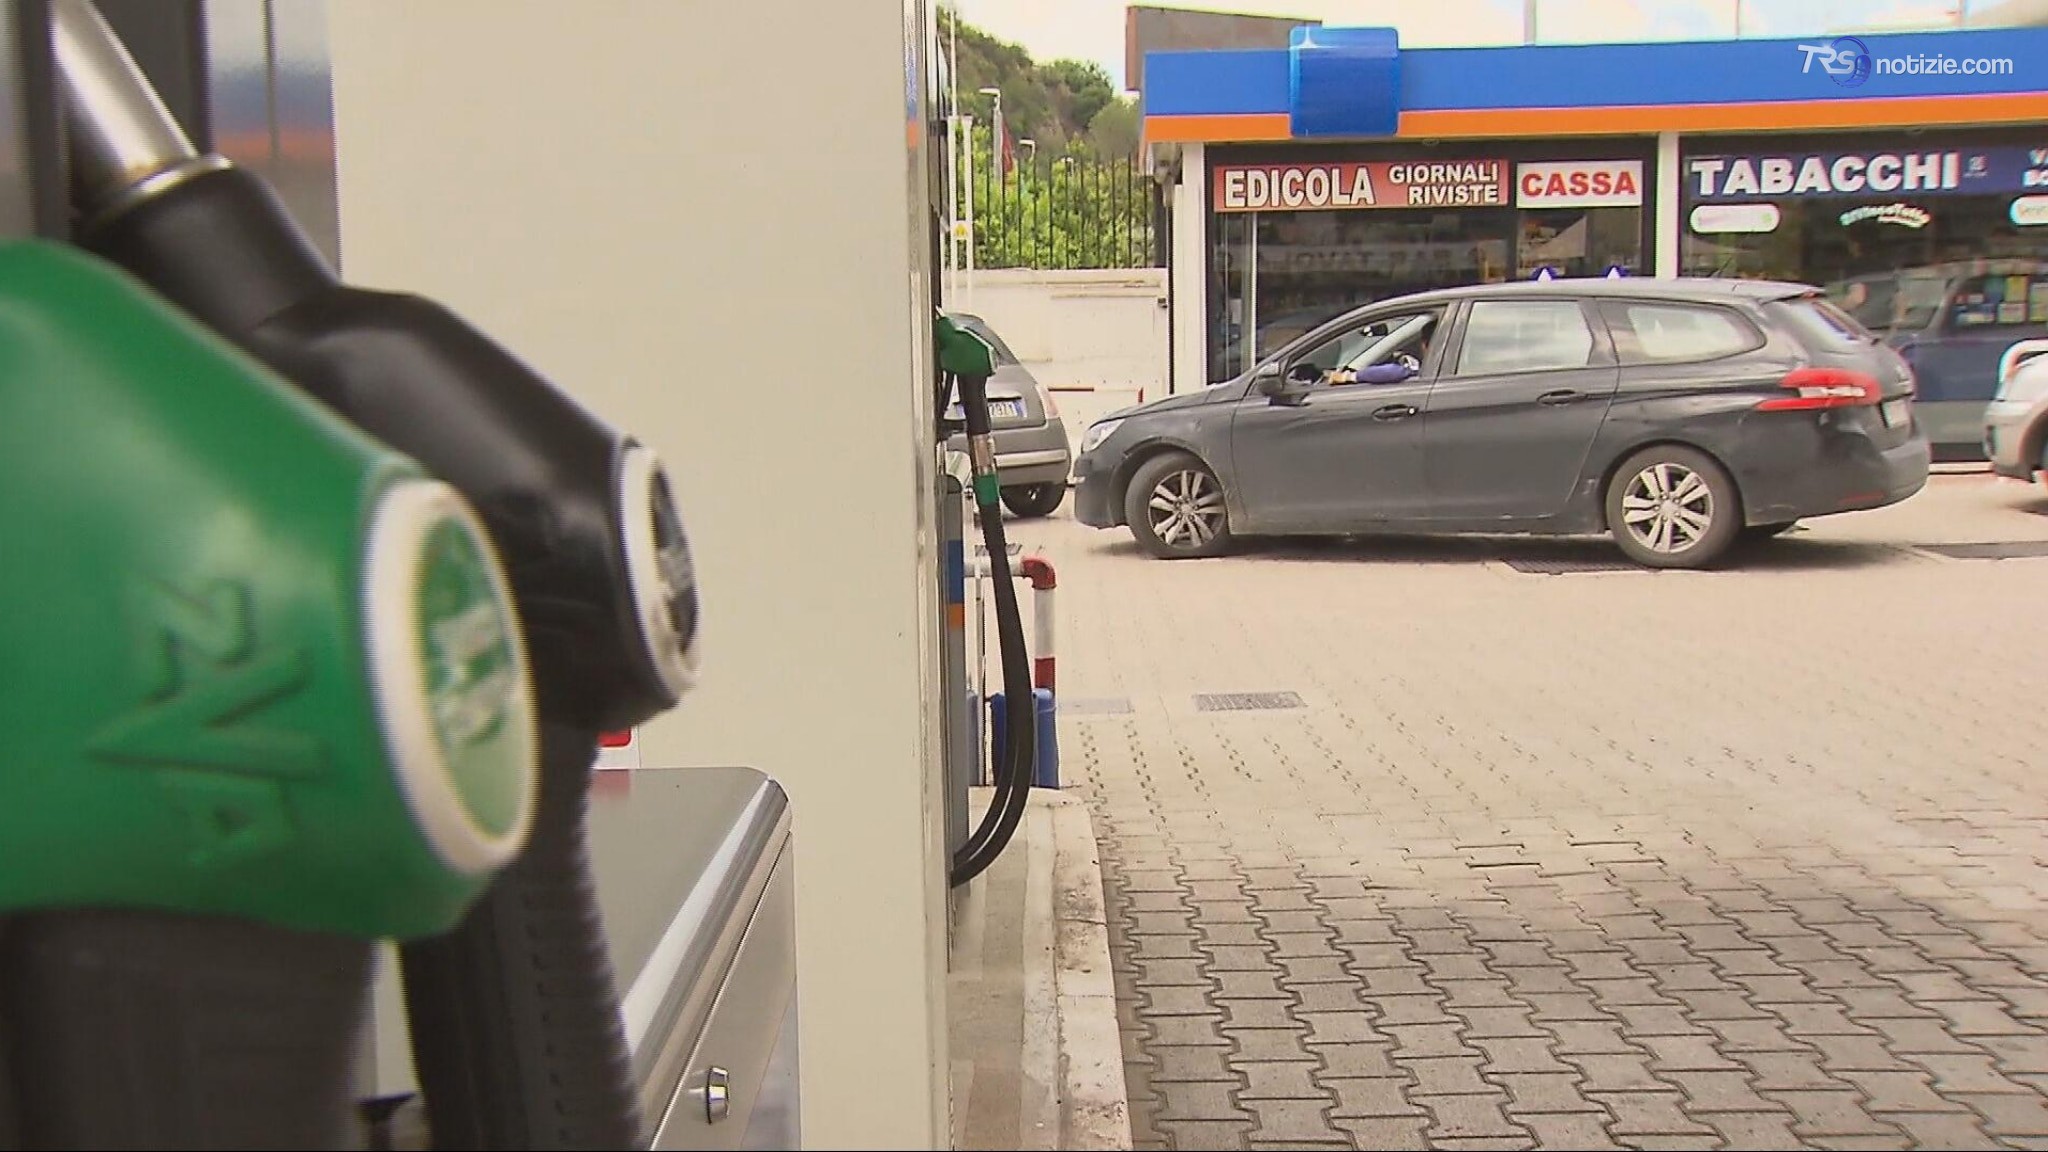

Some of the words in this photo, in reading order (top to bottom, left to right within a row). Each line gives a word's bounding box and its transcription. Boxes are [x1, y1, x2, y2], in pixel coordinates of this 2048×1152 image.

[1388, 163, 1499, 184] GIORNALI
[1521, 171, 1637, 196] CASSA
[1691, 152, 1960, 195] TABACCHI
[1224, 167, 1376, 208] EDICOLA
[1408, 184, 1499, 205] RIVISTE
